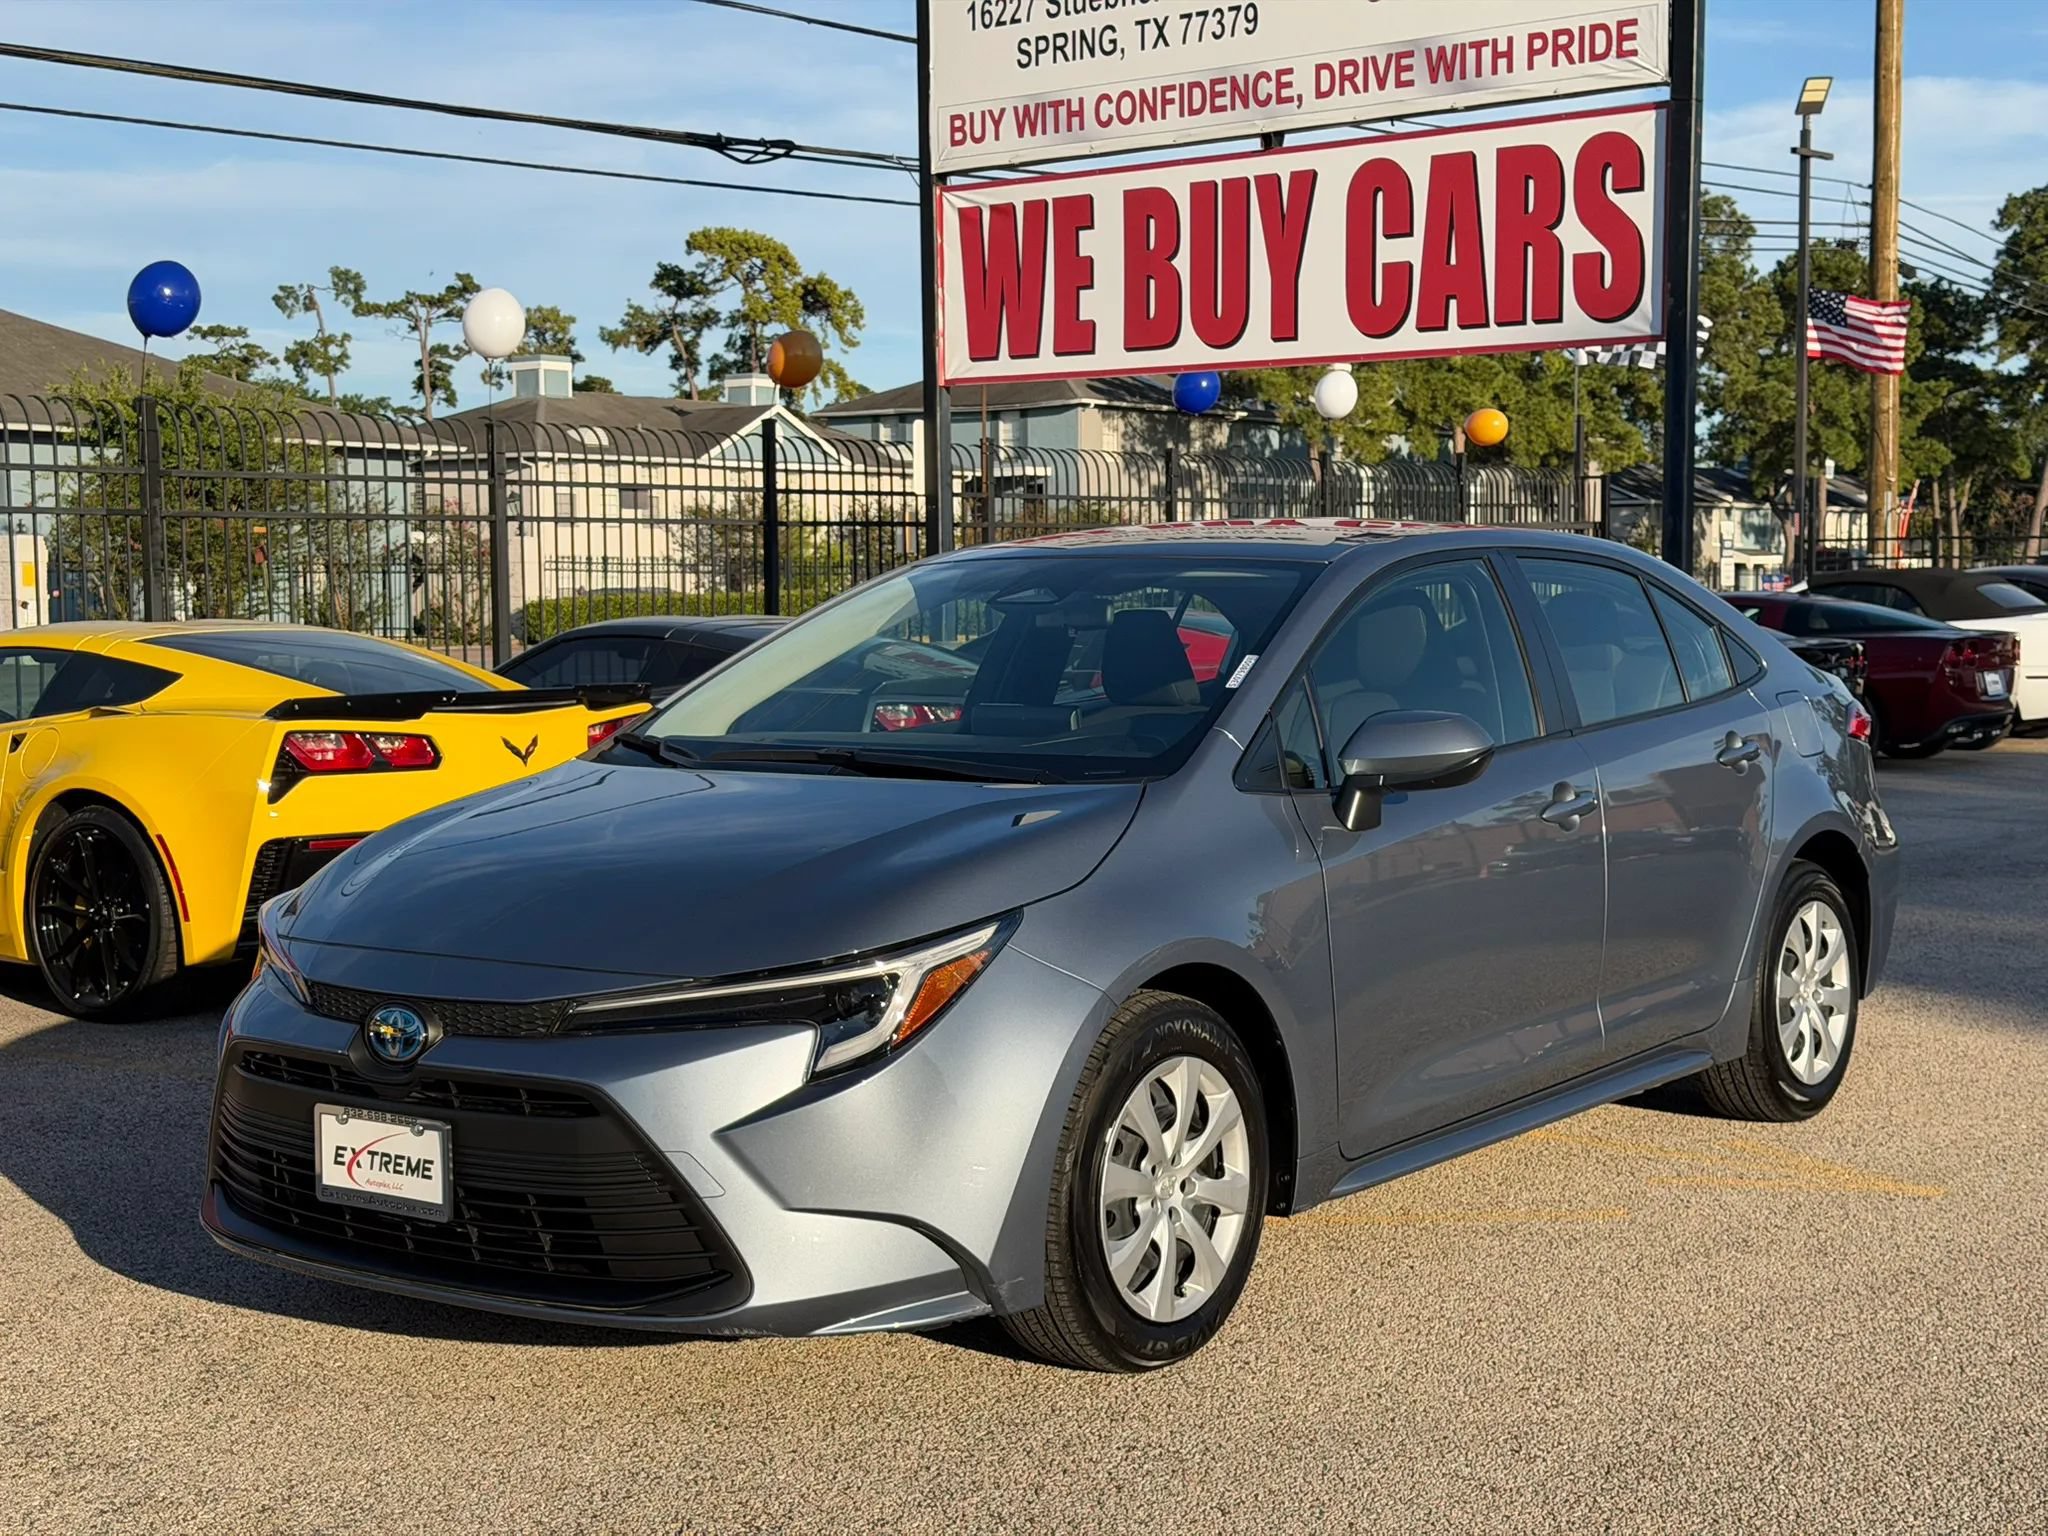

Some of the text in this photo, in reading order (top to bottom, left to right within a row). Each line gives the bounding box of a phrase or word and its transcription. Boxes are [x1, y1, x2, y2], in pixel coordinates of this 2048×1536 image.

[966, 0, 1034, 31] 16227
[1016, 2, 1260, 69] SPRING, TX 77379
[949, 18, 1639, 148] BUY WITH CONFIDENCE, DRIVE WITH PRIDE
[957, 130, 1646, 362] WE BUY CARS
[333, 1145, 435, 1181] EXTREME
